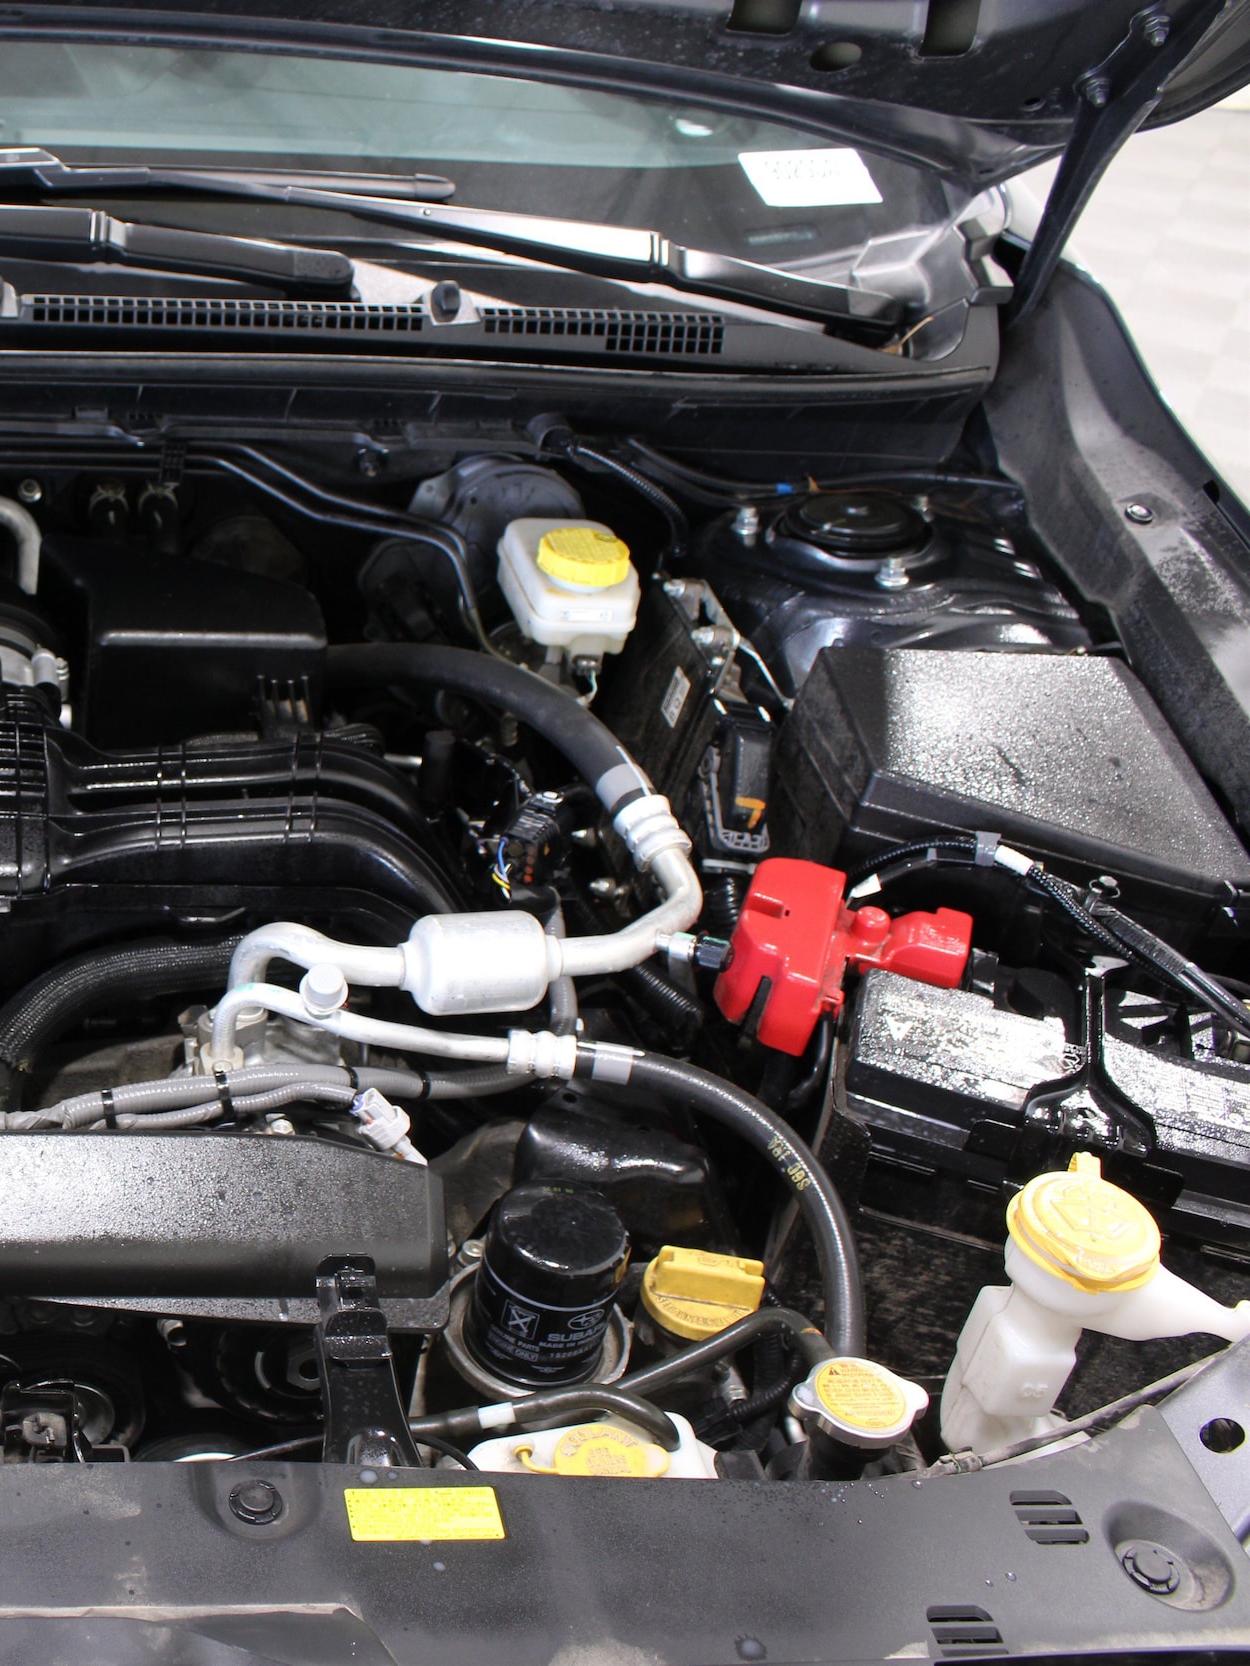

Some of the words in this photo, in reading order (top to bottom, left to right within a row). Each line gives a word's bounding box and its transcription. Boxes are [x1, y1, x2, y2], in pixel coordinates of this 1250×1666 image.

[517, 1340, 541, 1353] PARTS
[538, 1341, 564, 1349] MADE
[561, 1426, 638, 1456] COOLANT
